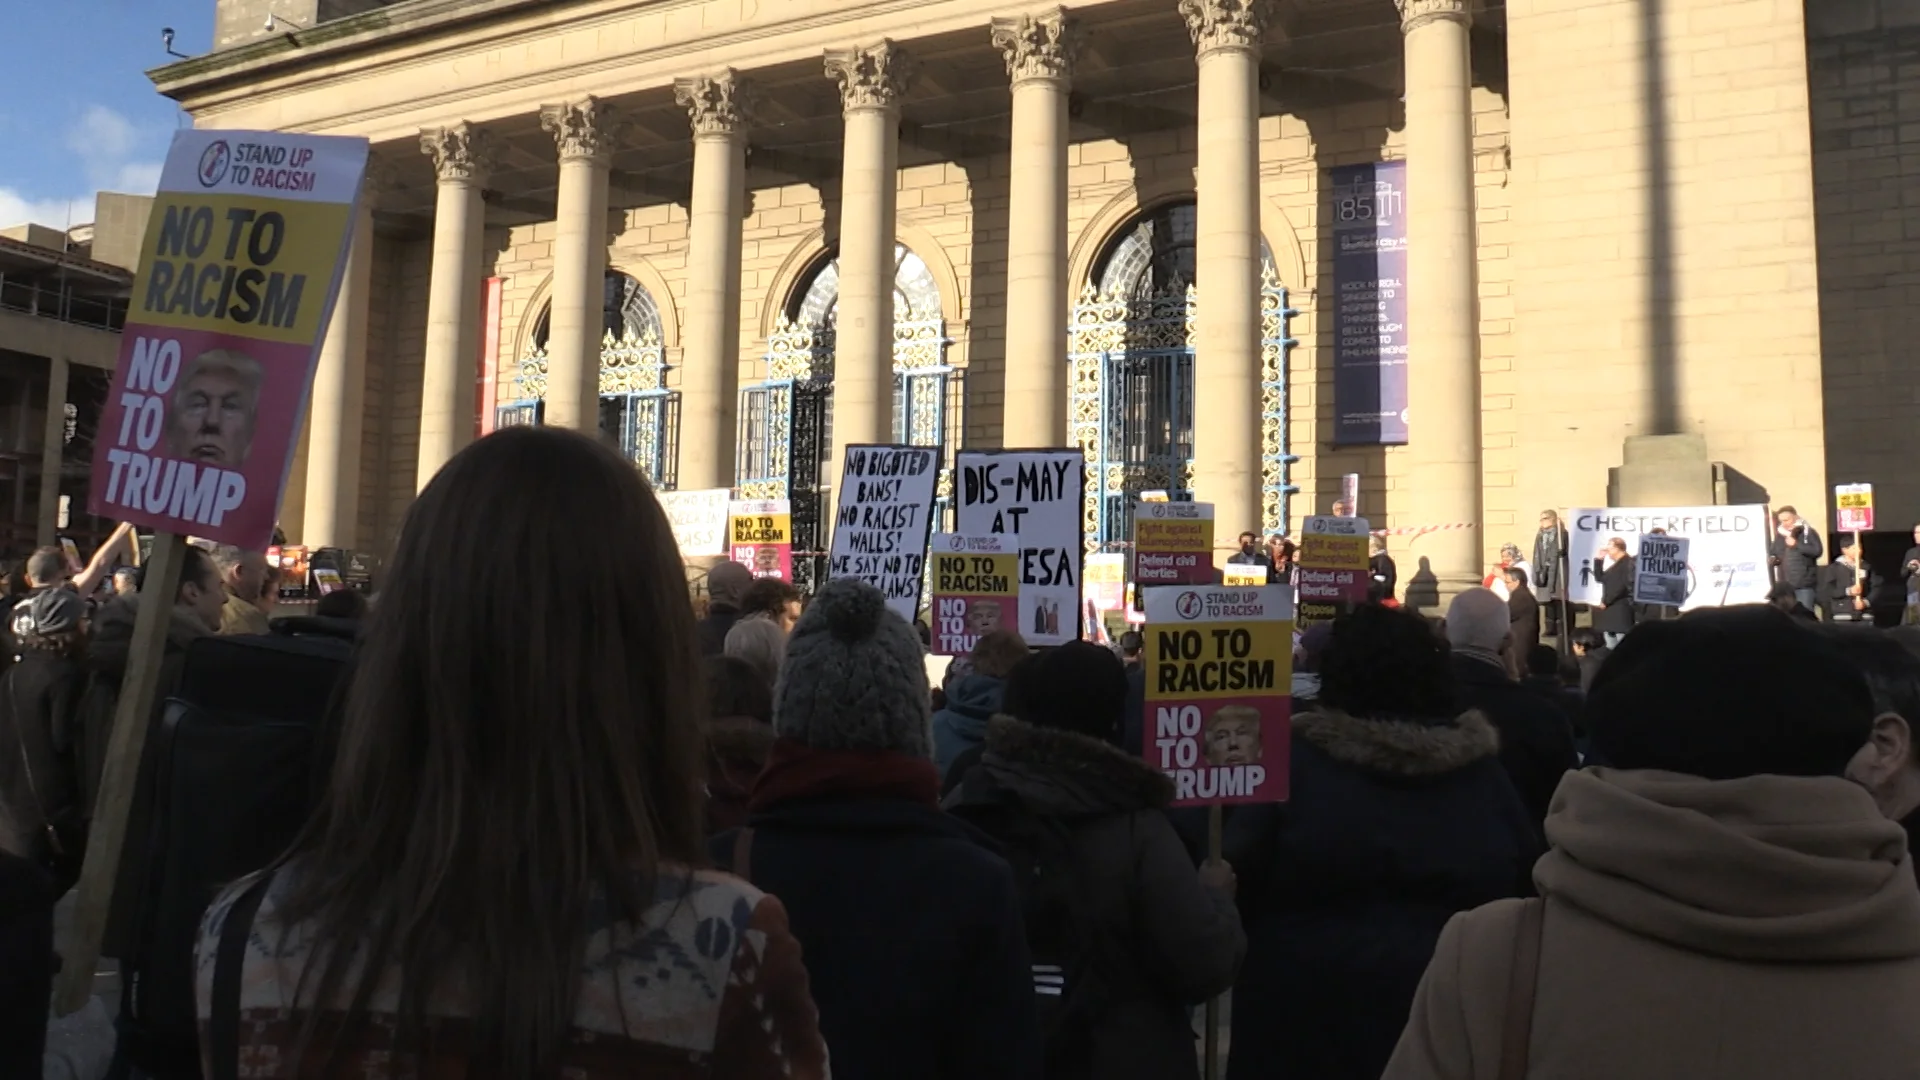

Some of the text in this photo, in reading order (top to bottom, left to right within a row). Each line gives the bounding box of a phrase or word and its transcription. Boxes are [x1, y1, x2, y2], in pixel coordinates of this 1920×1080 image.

[234, 142, 314, 169] STAND UP
[230, 166, 315, 192] TO RACISM
[156, 205, 285, 266] NO TO
[144, 260, 306, 329] RACISM
[126, 337, 181, 394] NO
[117, 393, 165, 452] TO
[846, 450, 931, 476] NO BIGOTED
[104, 448, 246, 528] TRUMP
[857, 479, 903, 504] BANS!
[964, 458, 1073, 506] DIS-MAY
[735, 517, 774, 529] NO TO
[838, 503, 920, 530] NO RACIST
[991, 507, 1029, 534] AT
[1576, 514, 1750, 533] CHESTERFIELD
[735, 529, 784, 541] RACISM
[850, 531, 904, 554] WALLS!
[735, 547, 755, 559] NO
[1139, 553, 1196, 567] Defend civil
[1642, 541, 1680, 558] DUMP
[831, 553, 921, 575] WE SAY NO TO
[939, 557, 994, 574] NO TO
[1139, 567, 1178, 579] liberties
[1641, 557, 1686, 575] TRUMP
[939, 574, 1008, 592] RACISM
[1301, 569, 1335, 582] Defend
[939, 598, 967, 616] NO
[1206, 592, 1259, 605] STAND UP
[1206, 604, 1264, 617] TO RACISM
[939, 616, 964, 634] TO
[939, 635, 983, 652] TRU
[1158, 628, 1251, 661] NO TO
[1158, 659, 1275, 693] RACISM
[1156, 705, 1201, 738] NO
[1155, 737, 1198, 769] TO
